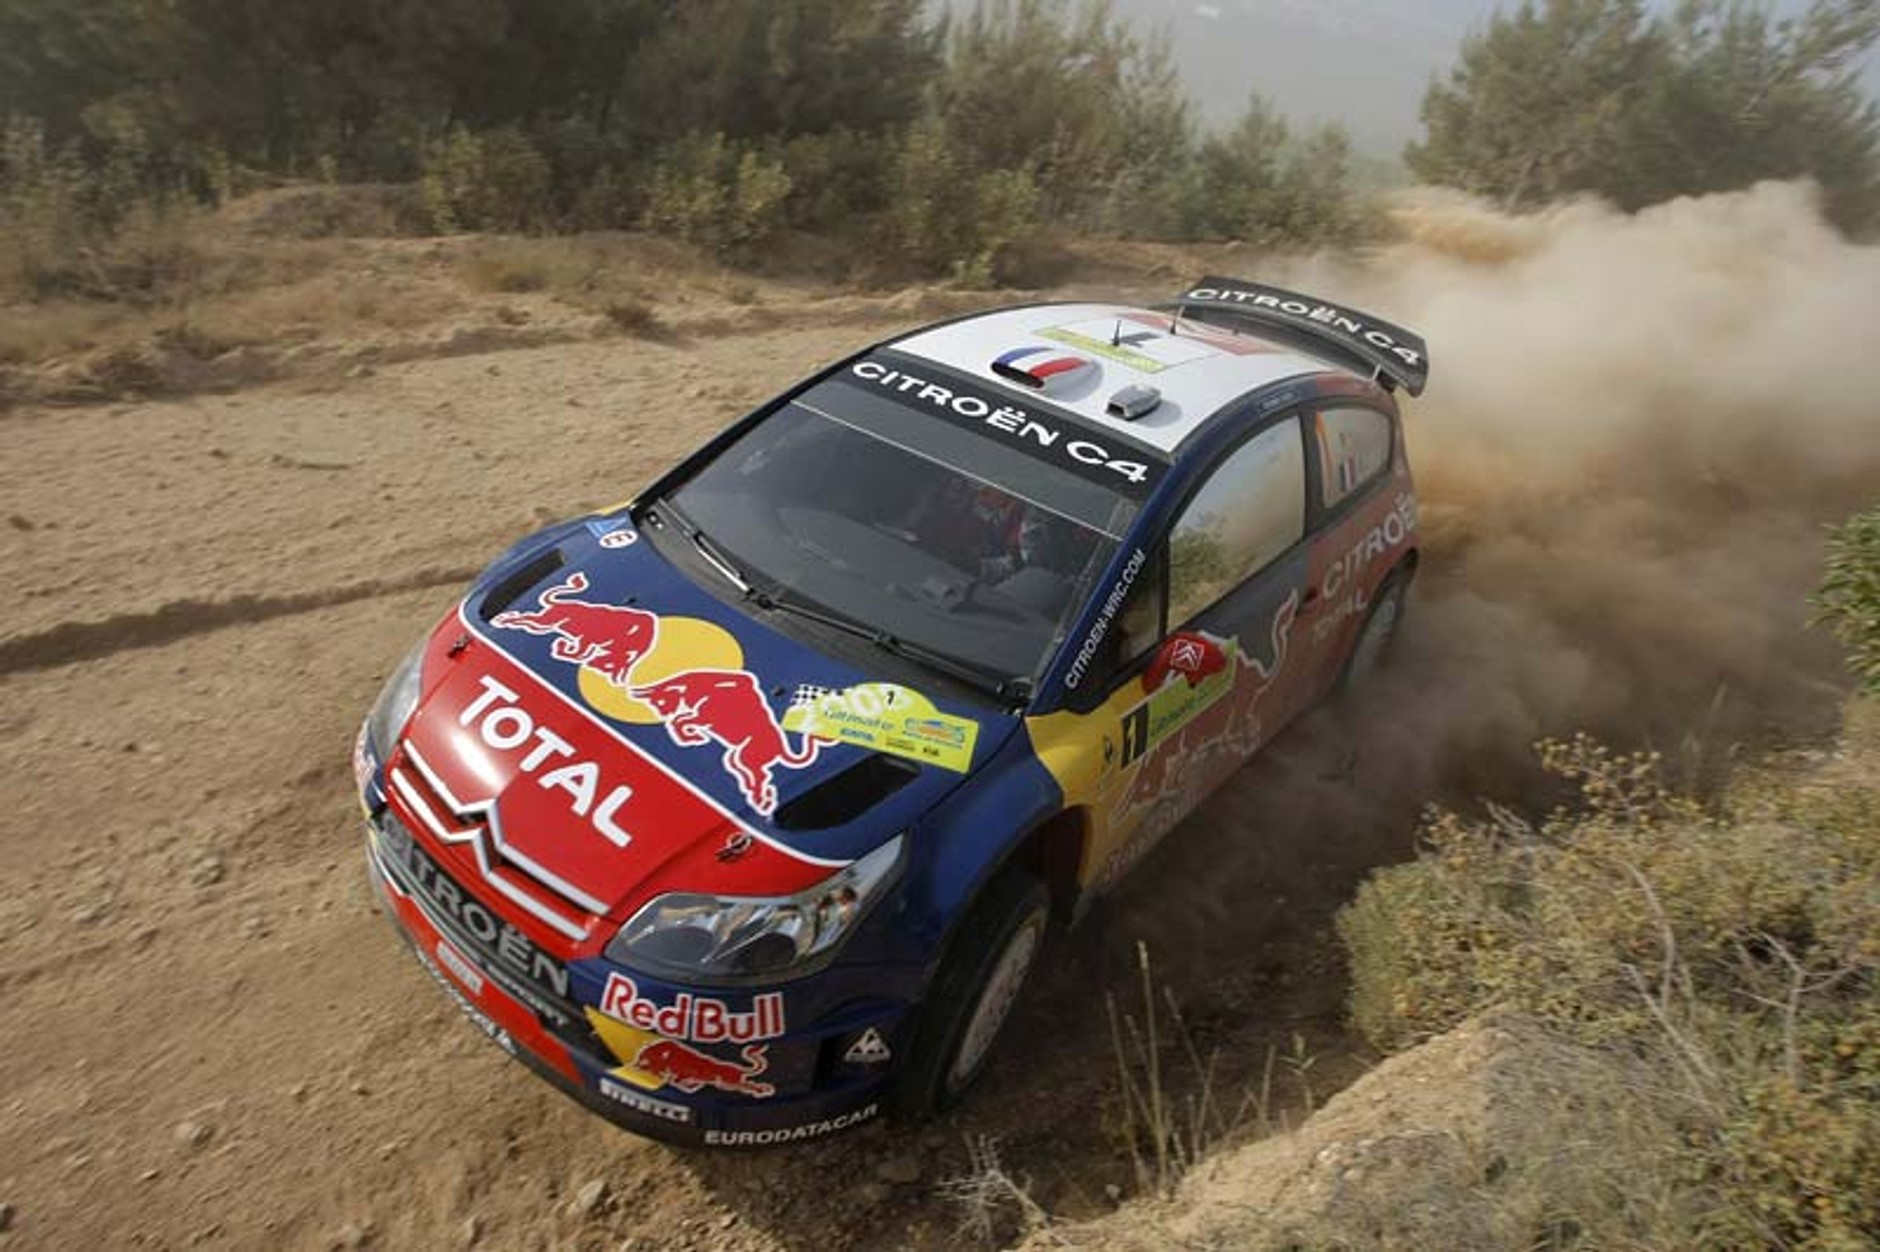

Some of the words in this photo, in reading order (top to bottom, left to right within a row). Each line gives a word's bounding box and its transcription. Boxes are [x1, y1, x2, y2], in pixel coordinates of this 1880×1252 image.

[1188, 288, 1362, 333] CITROËN
[1365, 331, 1420, 366] C4
[853, 362, 1059, 447] CITROËN
[1066, 441, 1149, 484] C4
[1323, 492, 1418, 599] CITROË
[459, 674, 634, 848] TOTAL
[382, 810, 569, 997] CITROËN
[601, 971, 693, 1040] Red
[692, 991, 785, 1044] Bull
[704, 1103, 879, 1146] EURODATACAR
